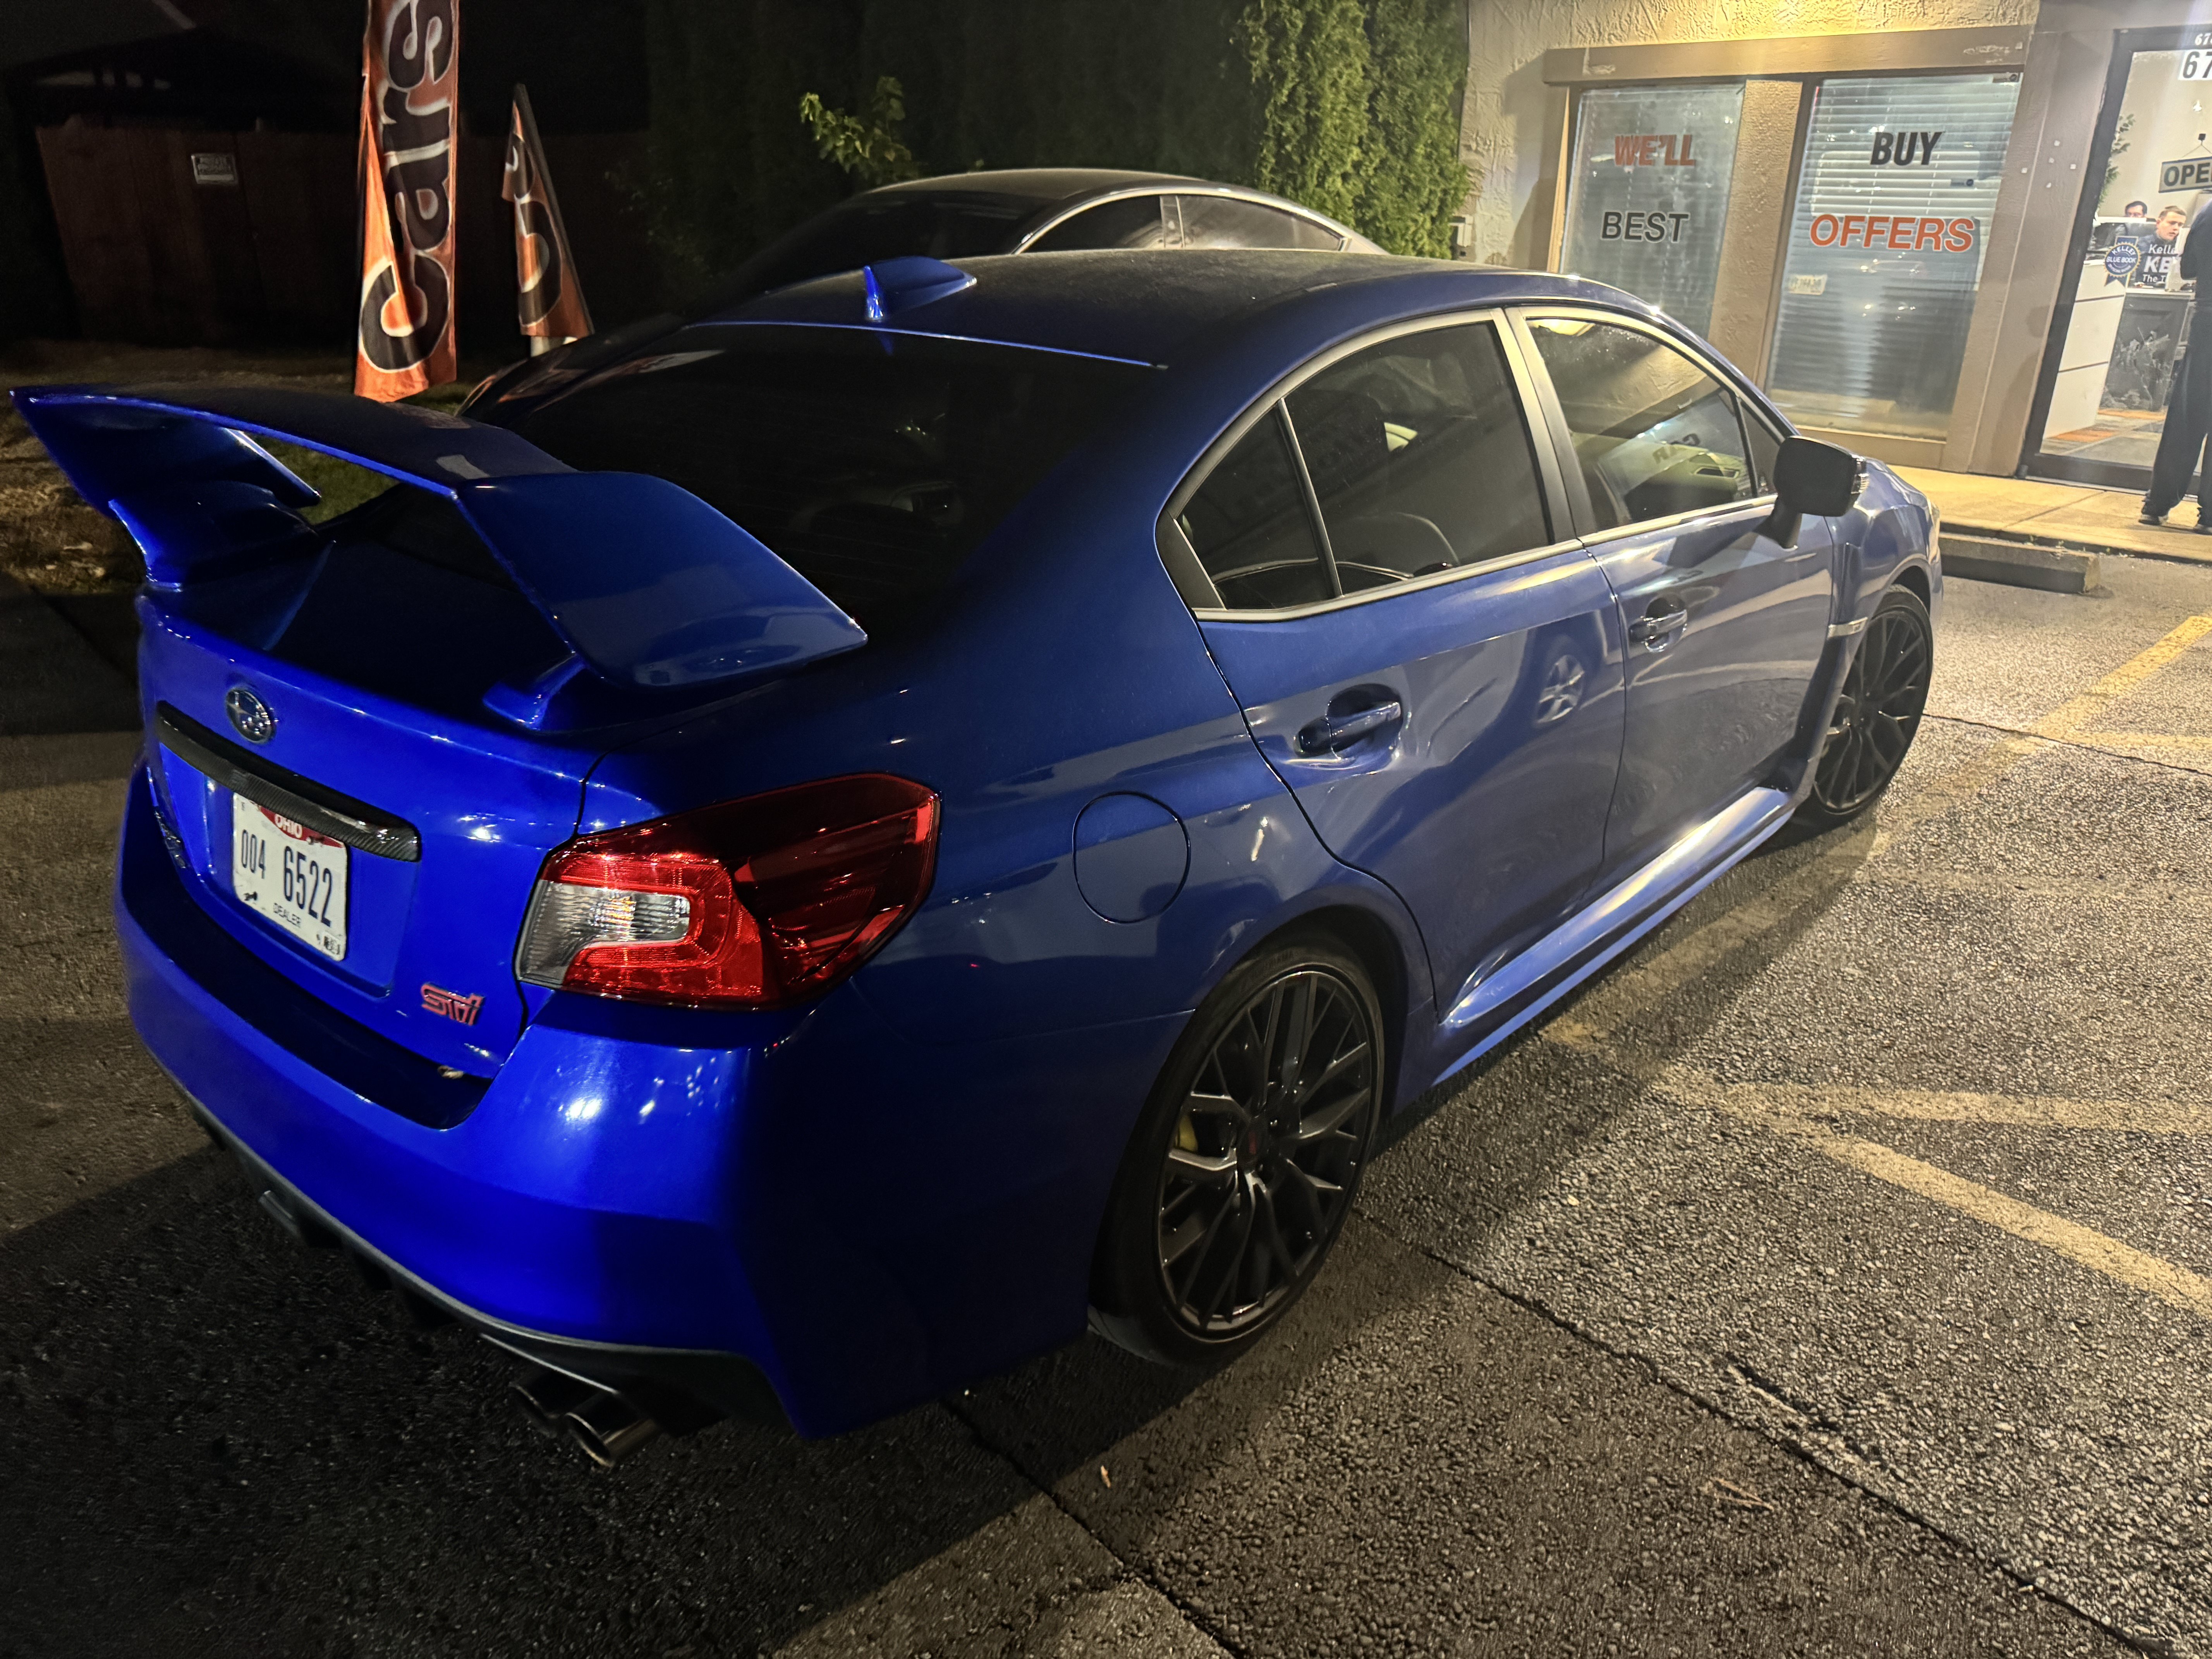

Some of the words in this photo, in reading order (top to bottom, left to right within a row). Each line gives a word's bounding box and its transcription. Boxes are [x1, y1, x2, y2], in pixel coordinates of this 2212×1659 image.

[2195, 33, 2212, 45] 67
[1614, 134, 1696, 167] WE'LL
[1870, 131, 1943, 166] BUY
[2164, 162, 2212, 187] OPE
[1601, 212, 1689, 242] BEST
[1809, 213, 1975, 252] OFFERS
[2112, 246, 2136, 256] KELLEY
[2143, 274, 2158, 282] The
[274, 813, 303, 838] OHIO
[241, 829, 266, 879] 004
[284, 845, 333, 928] 6522
[273, 902, 301, 929] DEALER
